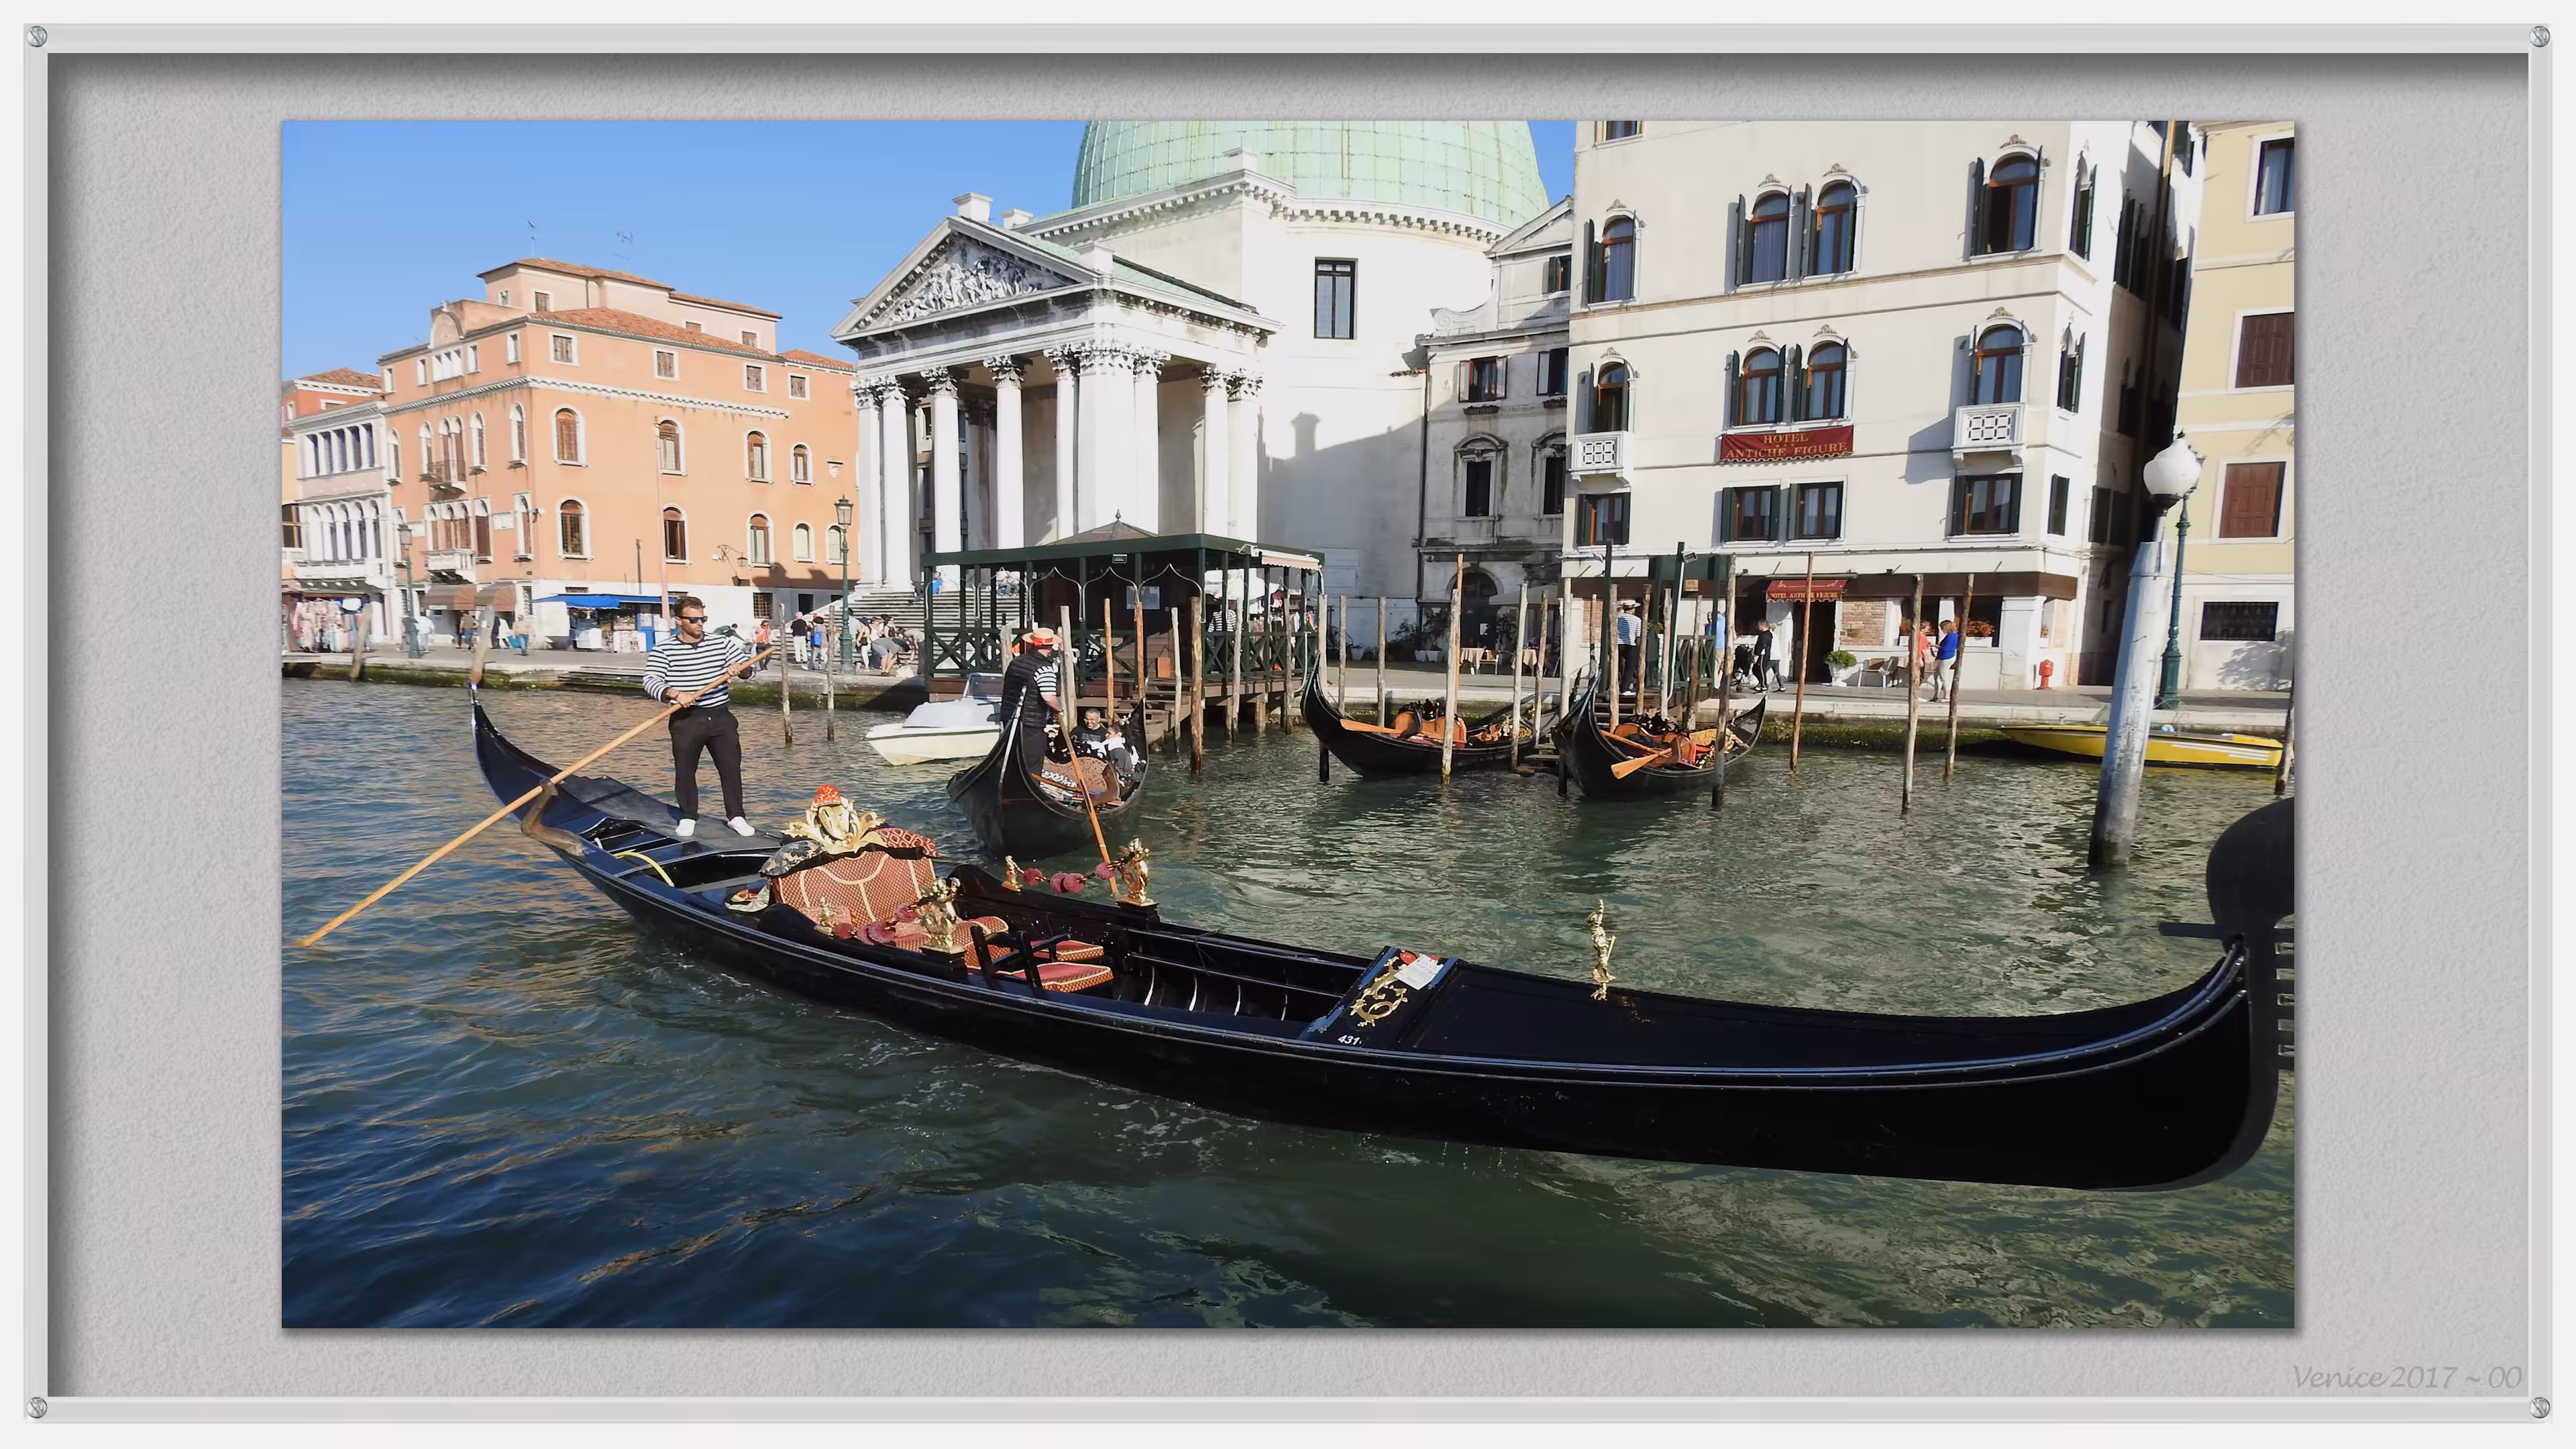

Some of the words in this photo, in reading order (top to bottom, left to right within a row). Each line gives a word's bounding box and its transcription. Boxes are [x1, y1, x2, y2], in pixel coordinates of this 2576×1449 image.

[1764, 433, 1809, 444] HOTEL
[1725, 447, 1787, 459] ANTICHE
[1794, 441, 1848, 455] FIGURE
